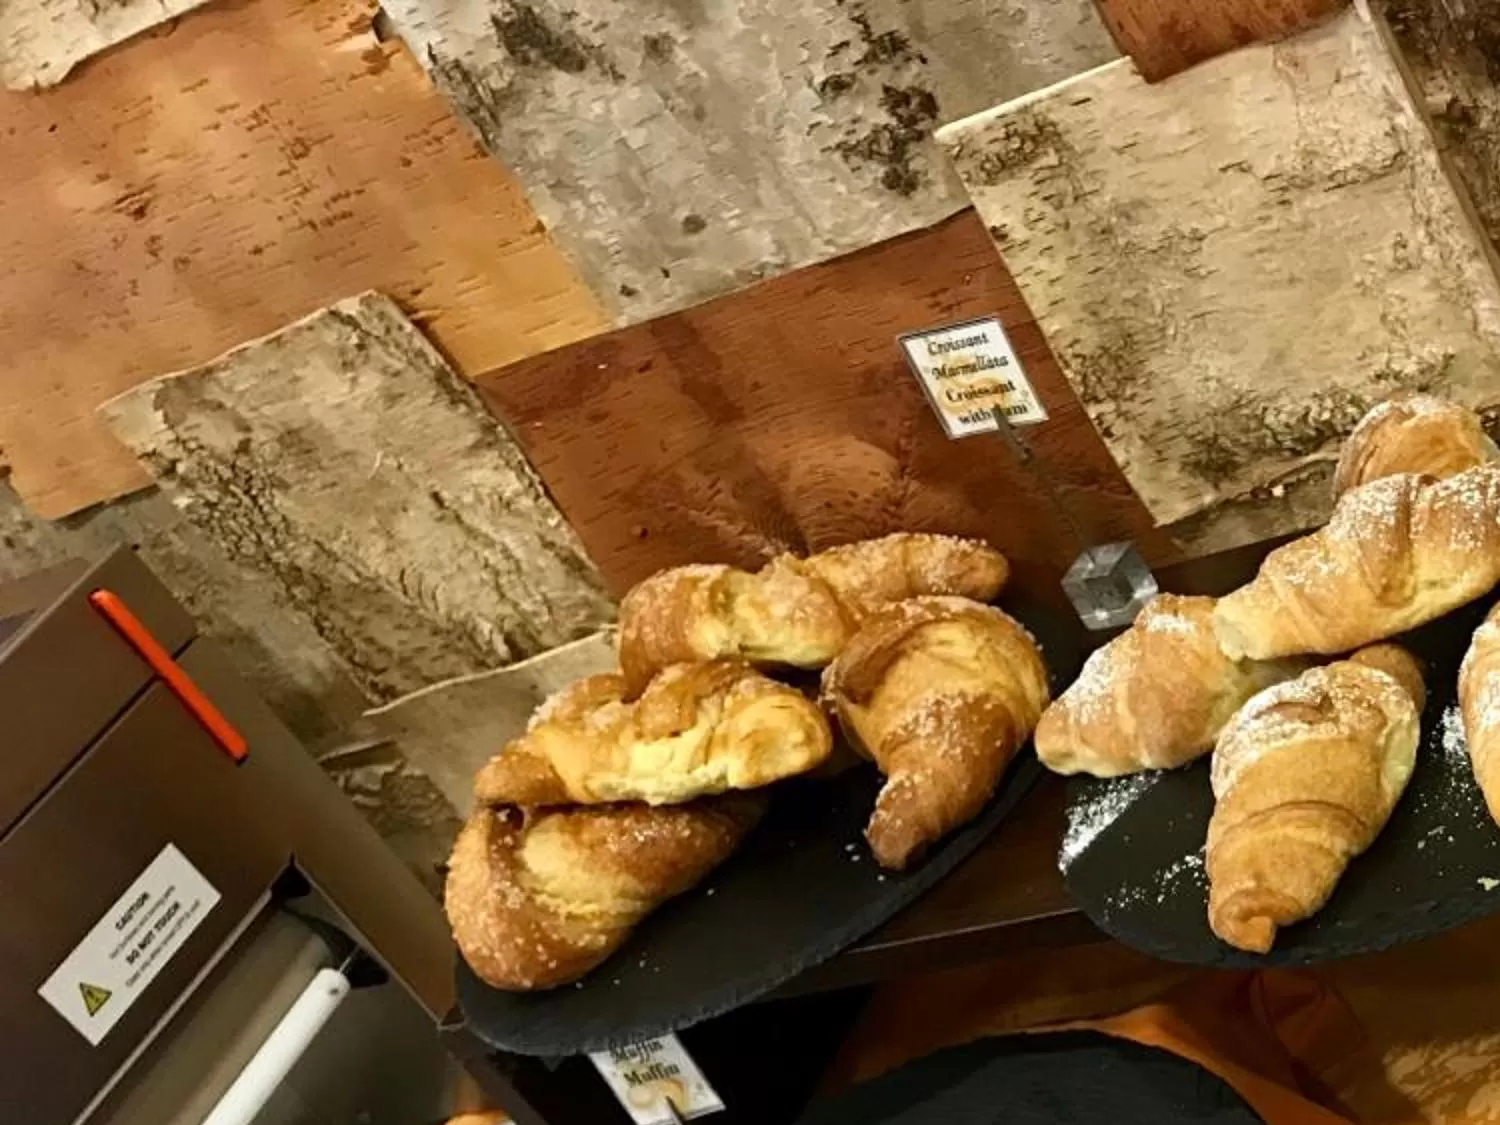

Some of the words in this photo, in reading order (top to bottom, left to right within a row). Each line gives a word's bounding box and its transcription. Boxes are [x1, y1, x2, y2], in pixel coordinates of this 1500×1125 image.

[928, 332, 990, 355] Croissant
[946, 380, 1017, 403] Croissant
[957, 407, 992, 425] with
[115, 891, 150, 931] CAUTION
